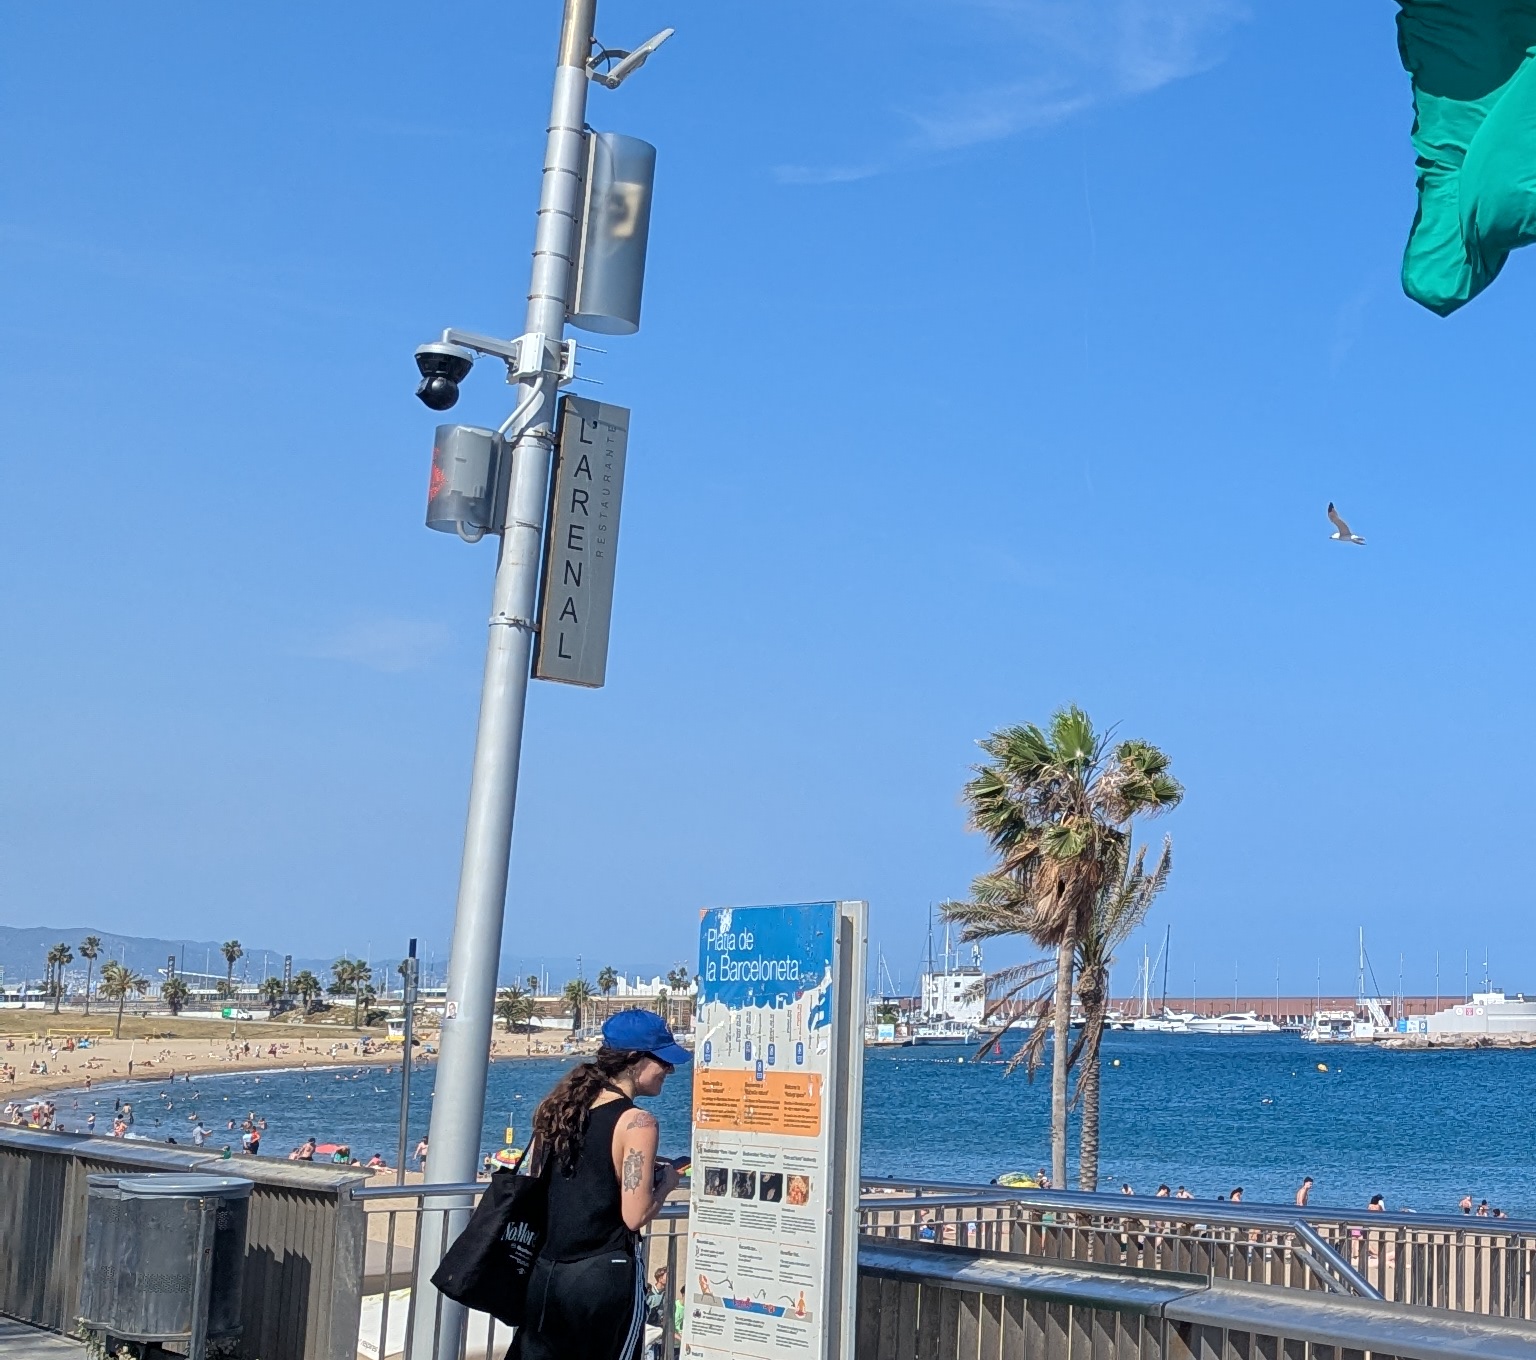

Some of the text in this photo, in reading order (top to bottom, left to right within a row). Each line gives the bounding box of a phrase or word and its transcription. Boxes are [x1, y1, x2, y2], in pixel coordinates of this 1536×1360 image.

[596, 425, 617, 558] RESTAURANTE
[557, 417, 598, 660] L'ARENAL
[705, 954, 799, 982] la Barceloneta
[738, 927, 754, 951] de
